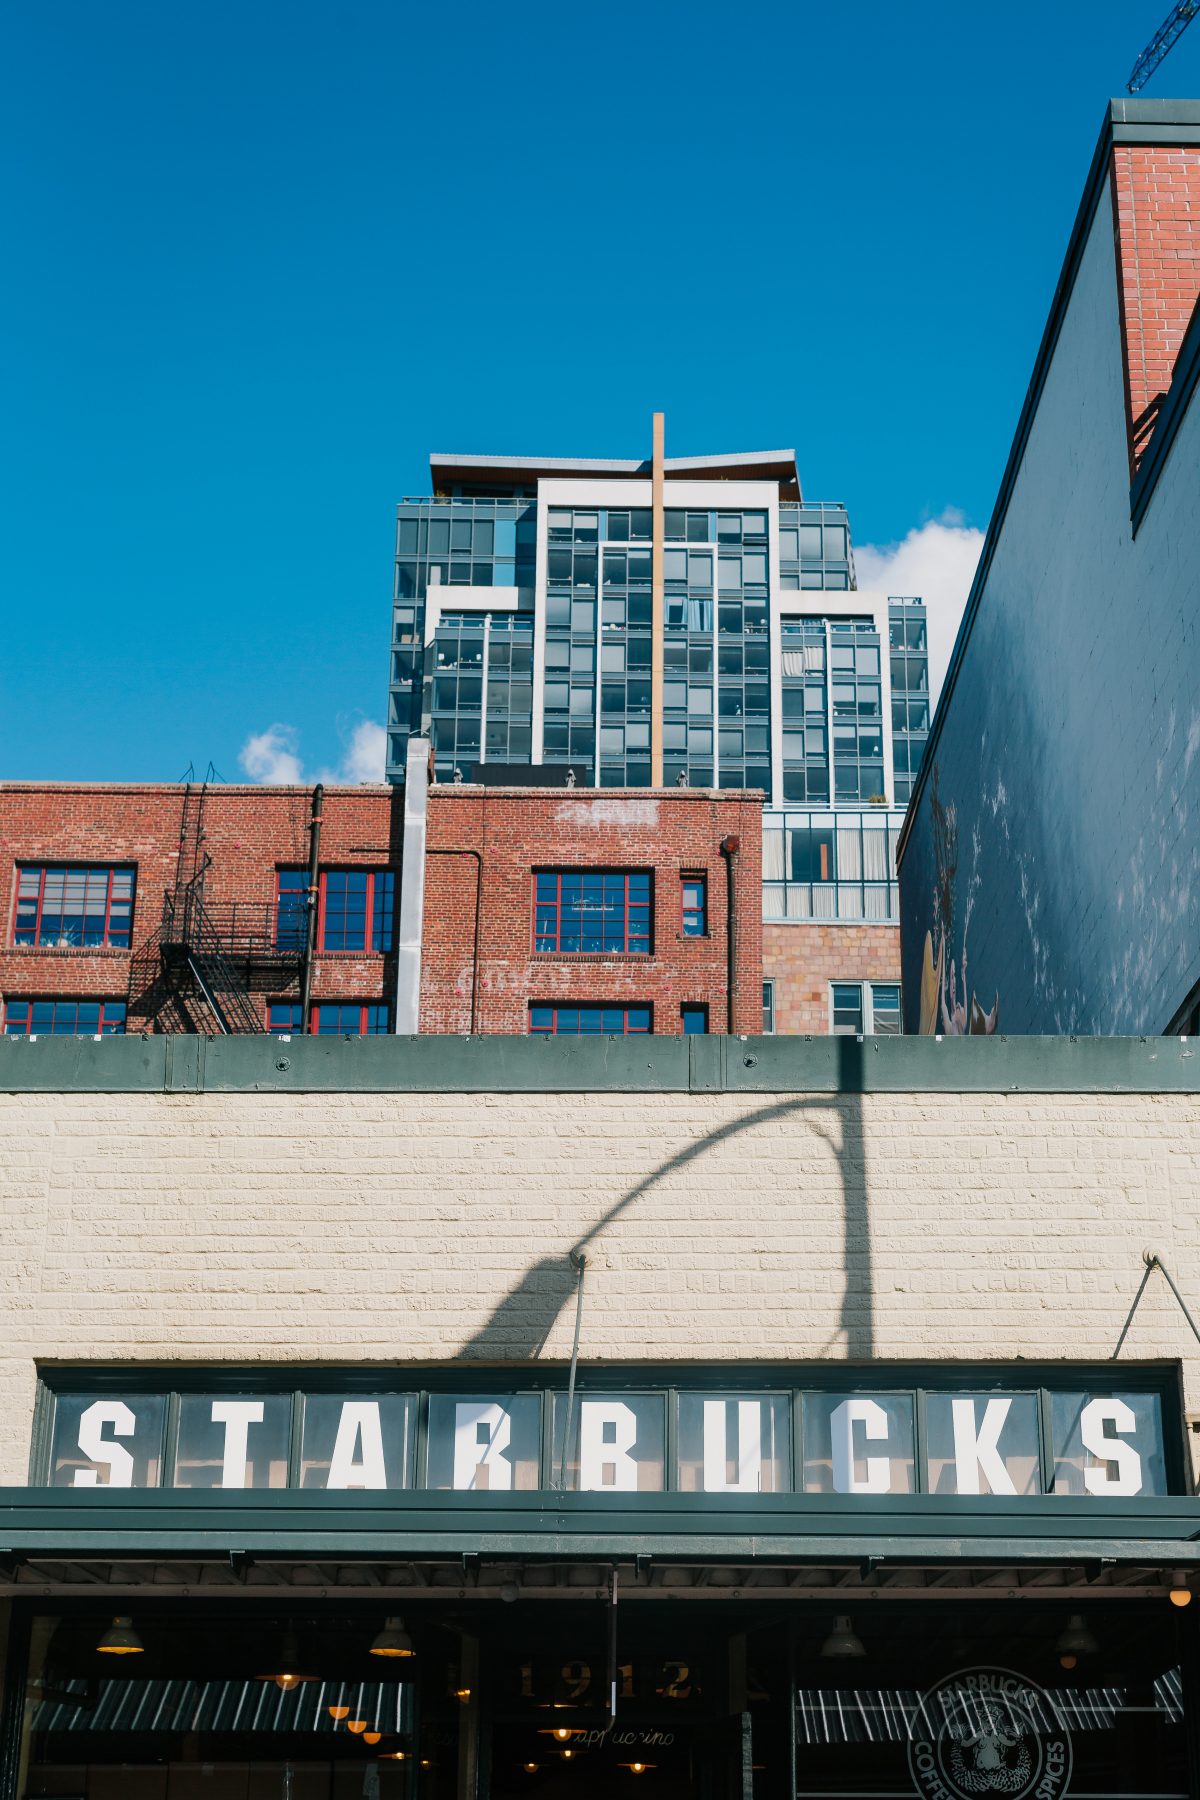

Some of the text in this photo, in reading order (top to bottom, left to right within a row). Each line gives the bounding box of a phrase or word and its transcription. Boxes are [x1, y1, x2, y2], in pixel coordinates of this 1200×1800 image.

[74, 1399, 1142, 1496] STARBUCKS
[520, 1661, 690, 1698] 1912
[937, 1674, 1040, 1709] STARBUCKS
[572, 1728, 675, 1748] apucino
[914, 1741, 956, 1800] COFFE
[1034, 1741, 1065, 1800] SPICES
